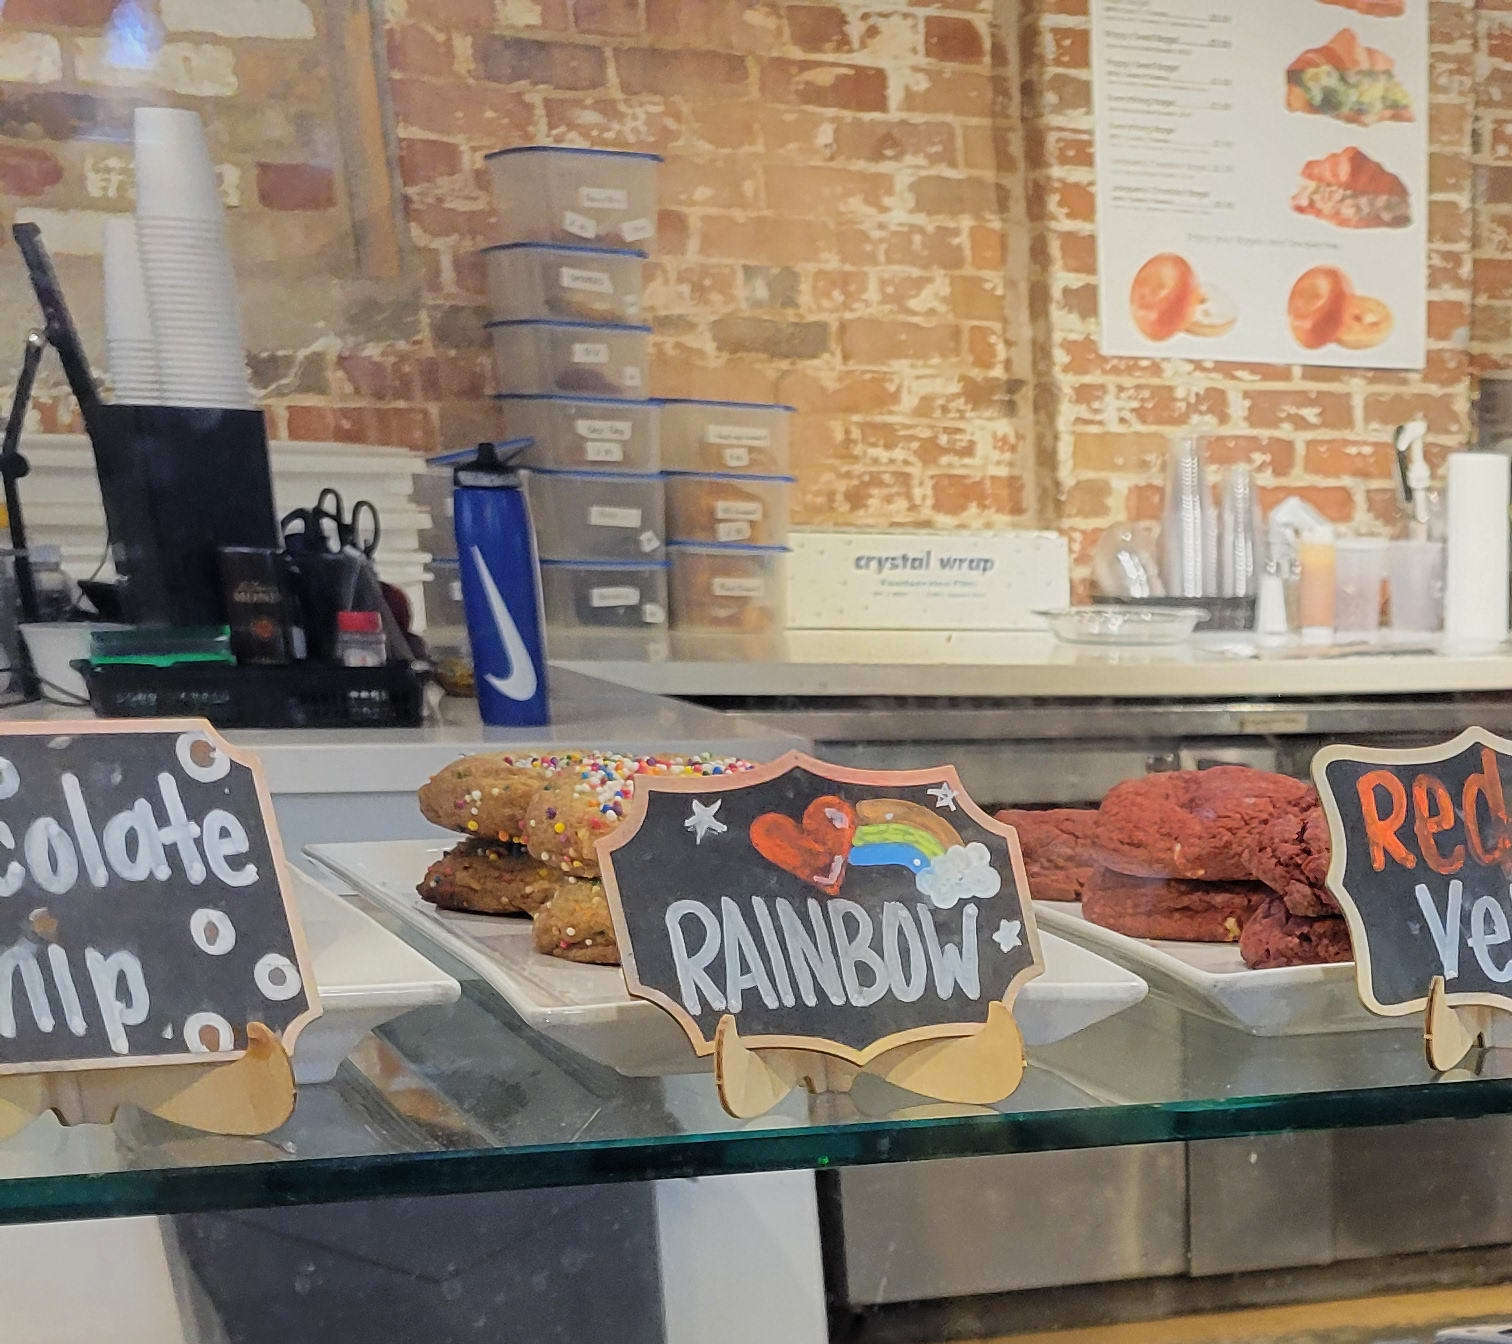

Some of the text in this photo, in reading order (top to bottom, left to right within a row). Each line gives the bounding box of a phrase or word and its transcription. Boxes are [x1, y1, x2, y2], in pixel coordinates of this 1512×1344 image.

[854, 550, 994, 576] crystal wrap
[665, 896, 981, 1015] RAINBOW
